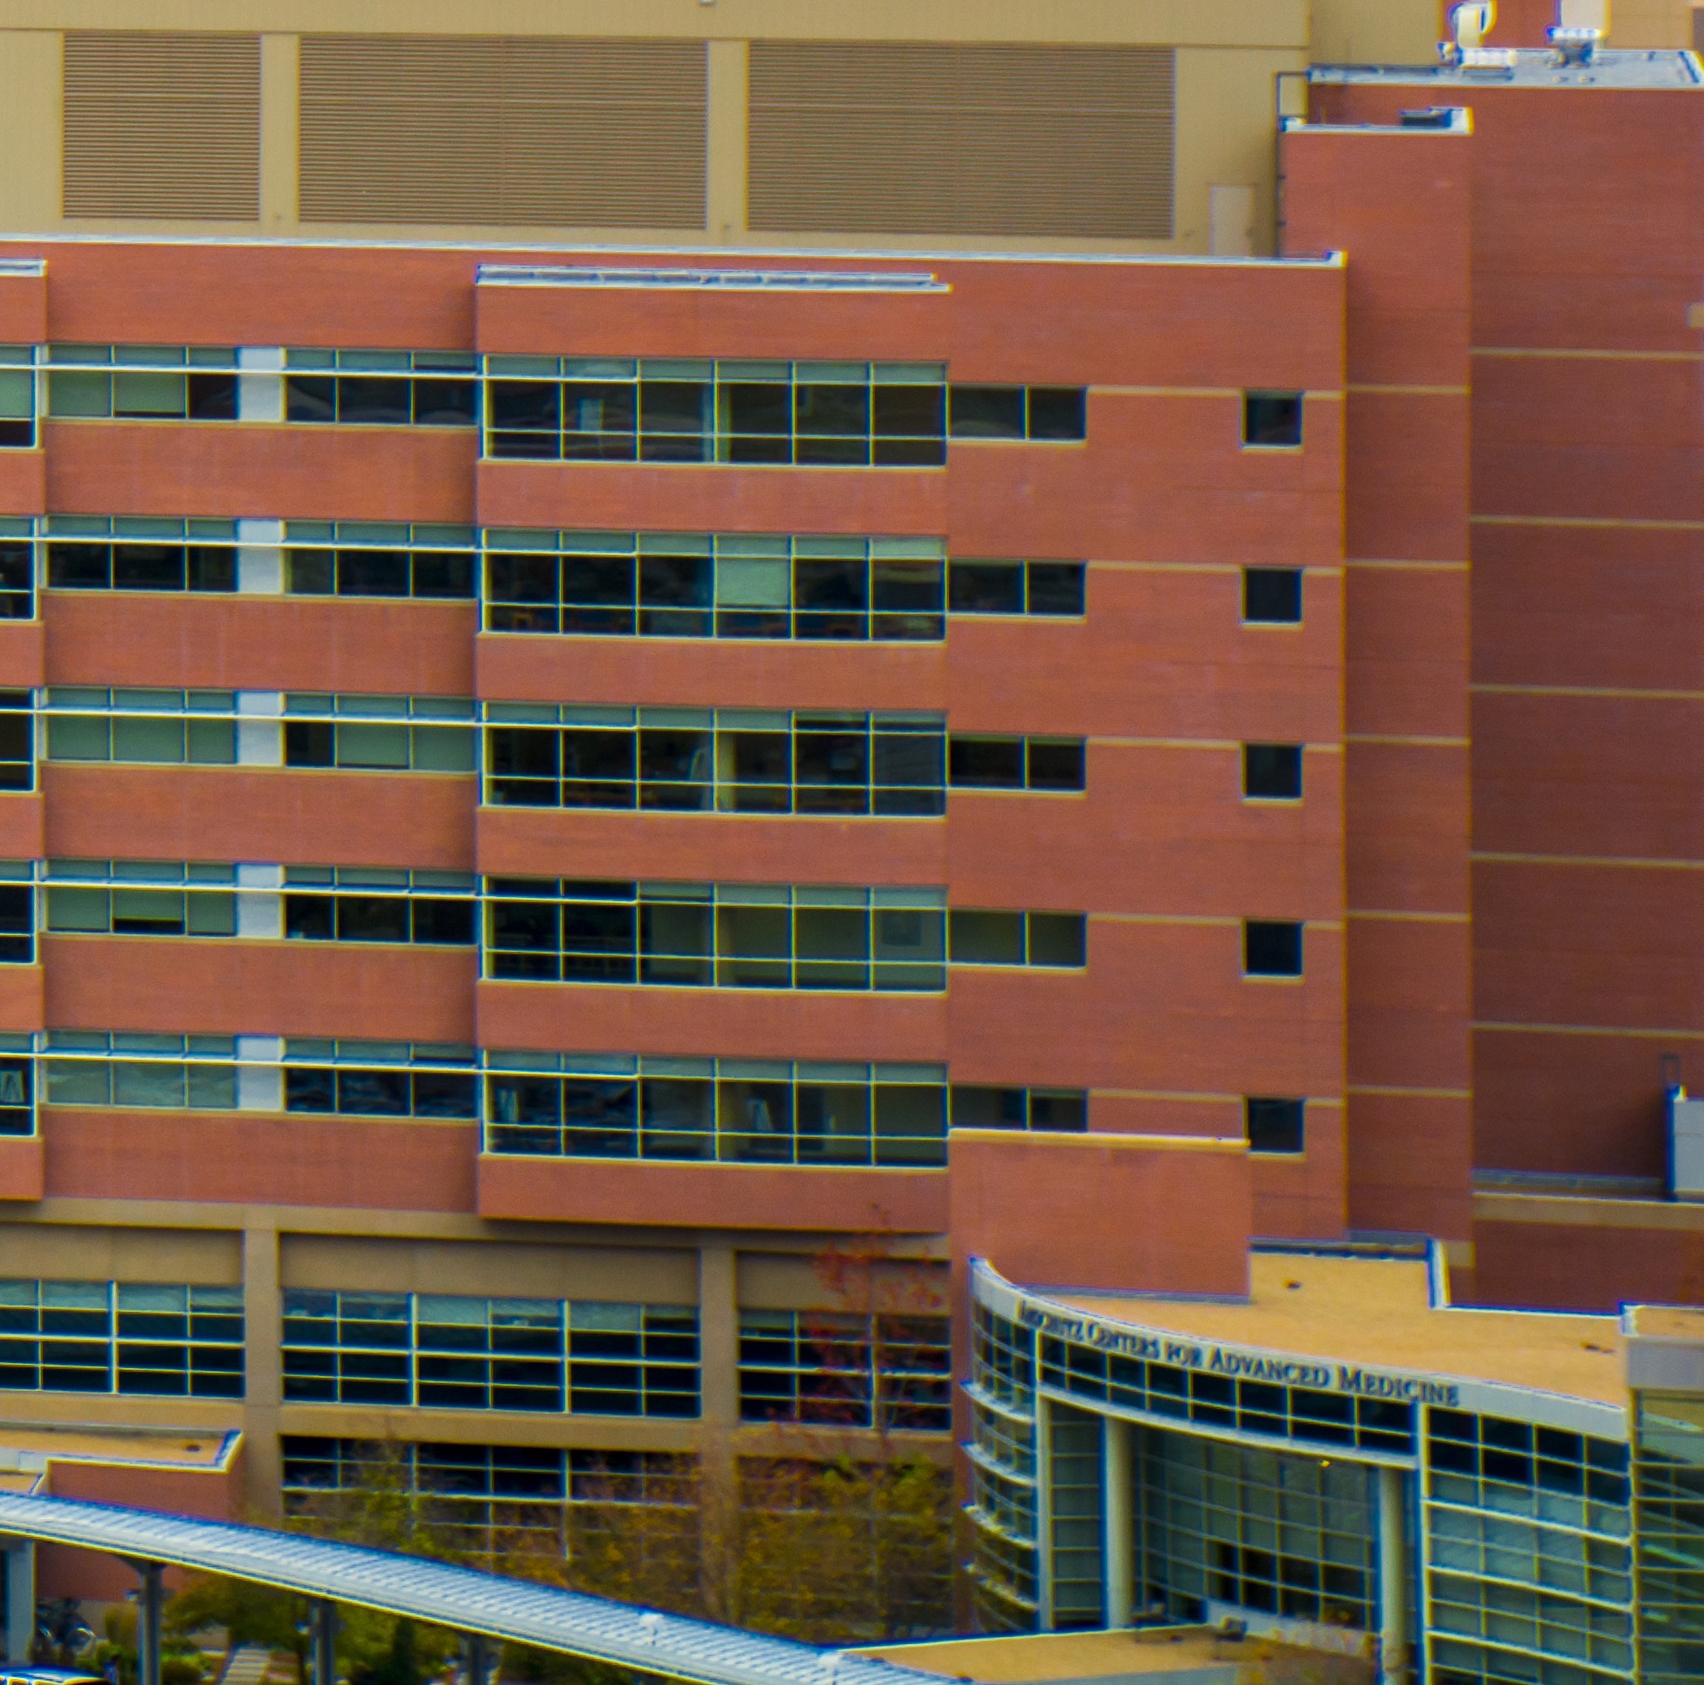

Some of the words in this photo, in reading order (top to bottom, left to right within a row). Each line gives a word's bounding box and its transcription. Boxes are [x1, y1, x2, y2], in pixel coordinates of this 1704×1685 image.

[1086, 1319, 1160, 1360] CENTERS
[1164, 1339, 1203, 1366] FOR
[1209, 1346, 1331, 1388] ADVANCED
[1335, 1365, 1461, 1407] MEDICINE
